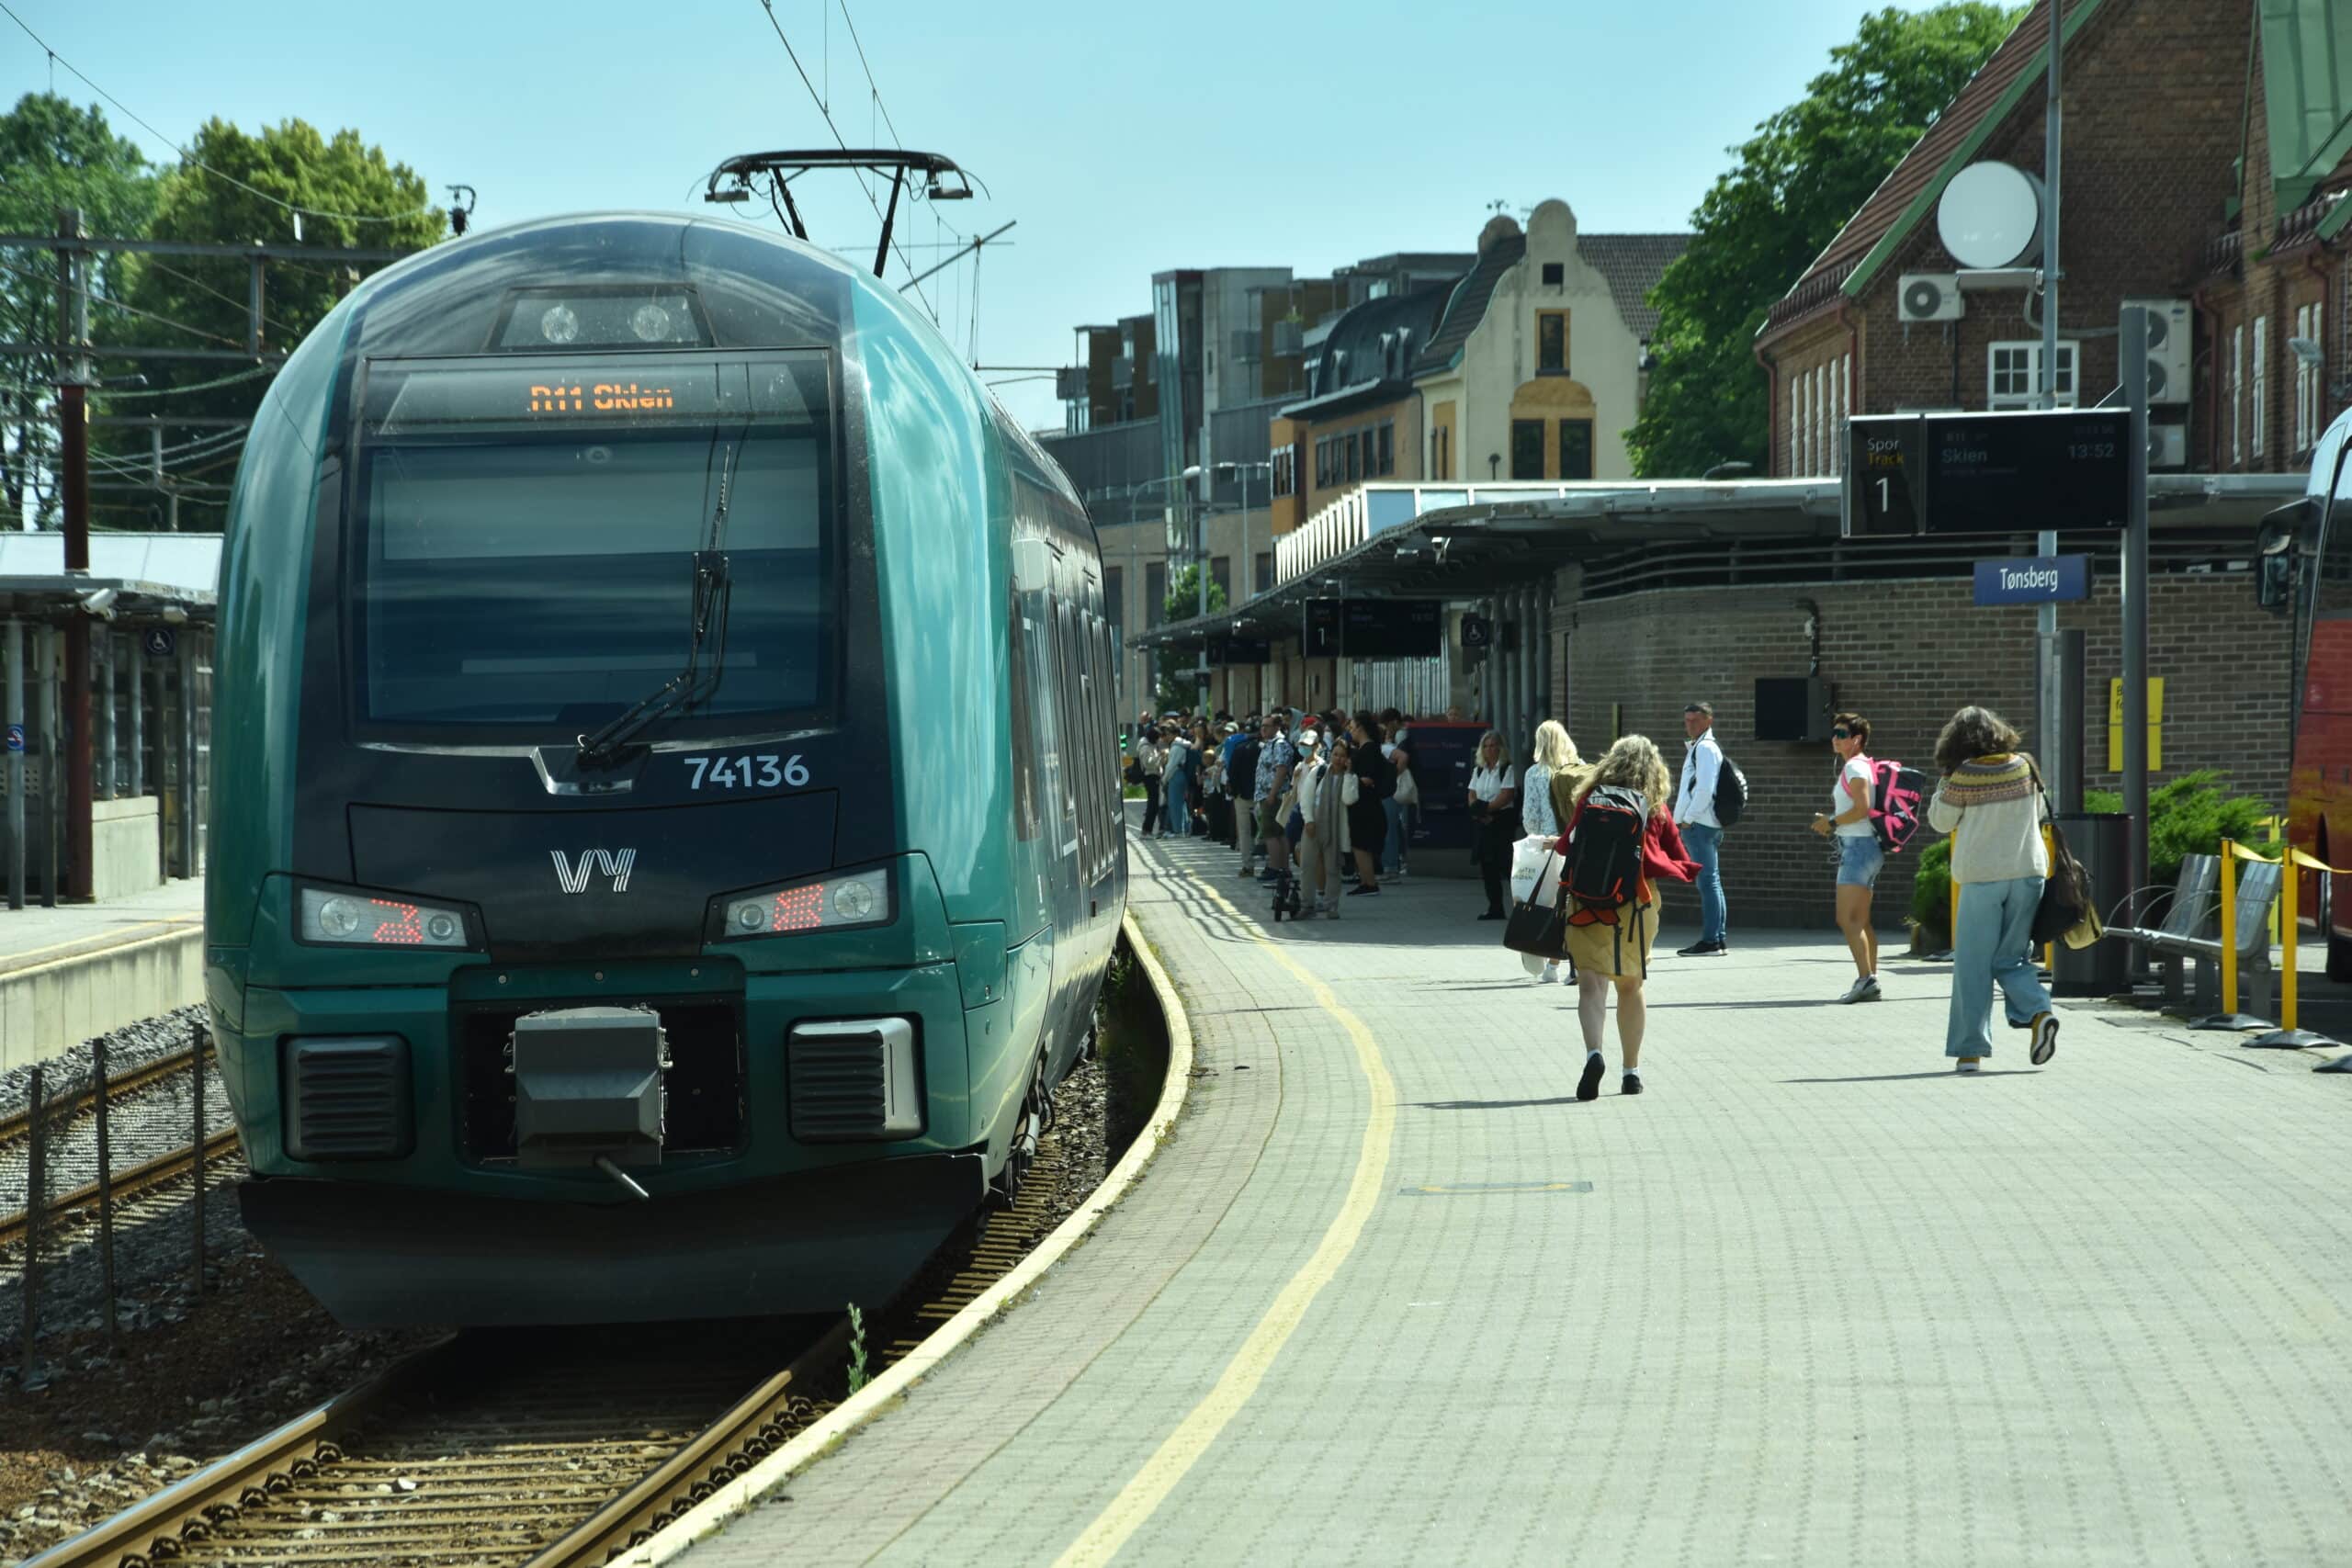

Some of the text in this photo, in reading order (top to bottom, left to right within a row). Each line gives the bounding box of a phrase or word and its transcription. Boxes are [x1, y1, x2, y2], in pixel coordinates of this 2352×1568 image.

[1867, 437, 1899, 453] Spor
[2067, 443, 2116, 458] 13:52
[1867, 451, 1904, 465] Track
[1940, 447, 1988, 464] Skien
[1875, 477, 1889, 513] 1
[1999, 565, 2058, 592] Tønsberg
[684, 754, 810, 790] 74136
